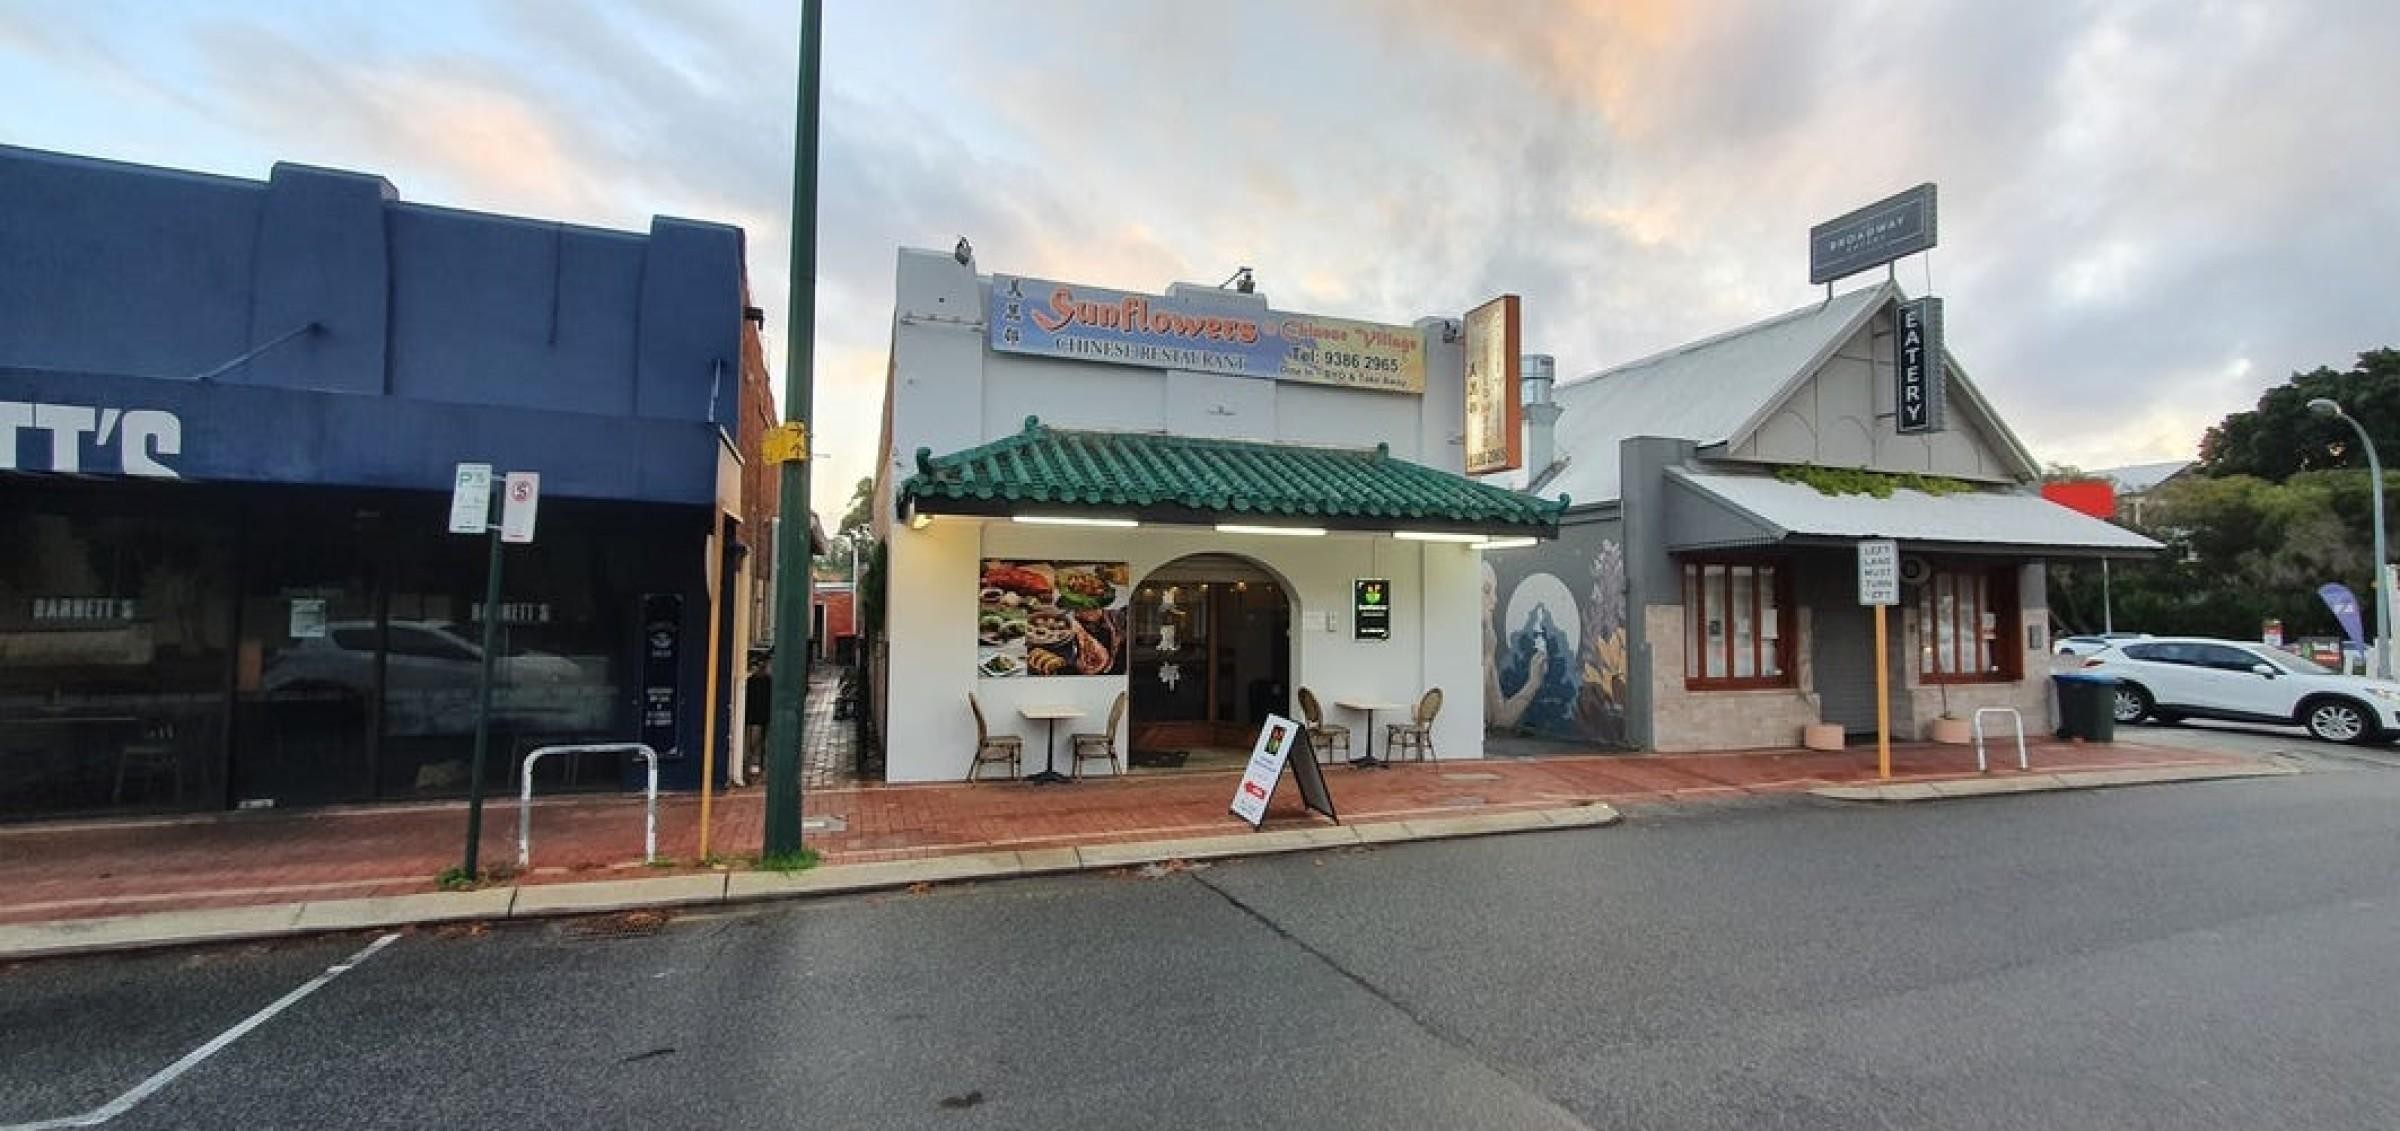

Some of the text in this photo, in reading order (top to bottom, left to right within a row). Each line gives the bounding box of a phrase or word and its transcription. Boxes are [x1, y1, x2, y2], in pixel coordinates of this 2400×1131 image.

[1032, 286, 1261, 344] Sunflowers
[1056, 338, 1247, 371] CHINESE RESTAURANT
[1324, 351, 1360, 369] 9386
[1364, 356, 1399, 372] 2965
[1905, 310, 1921, 421] EATERY
